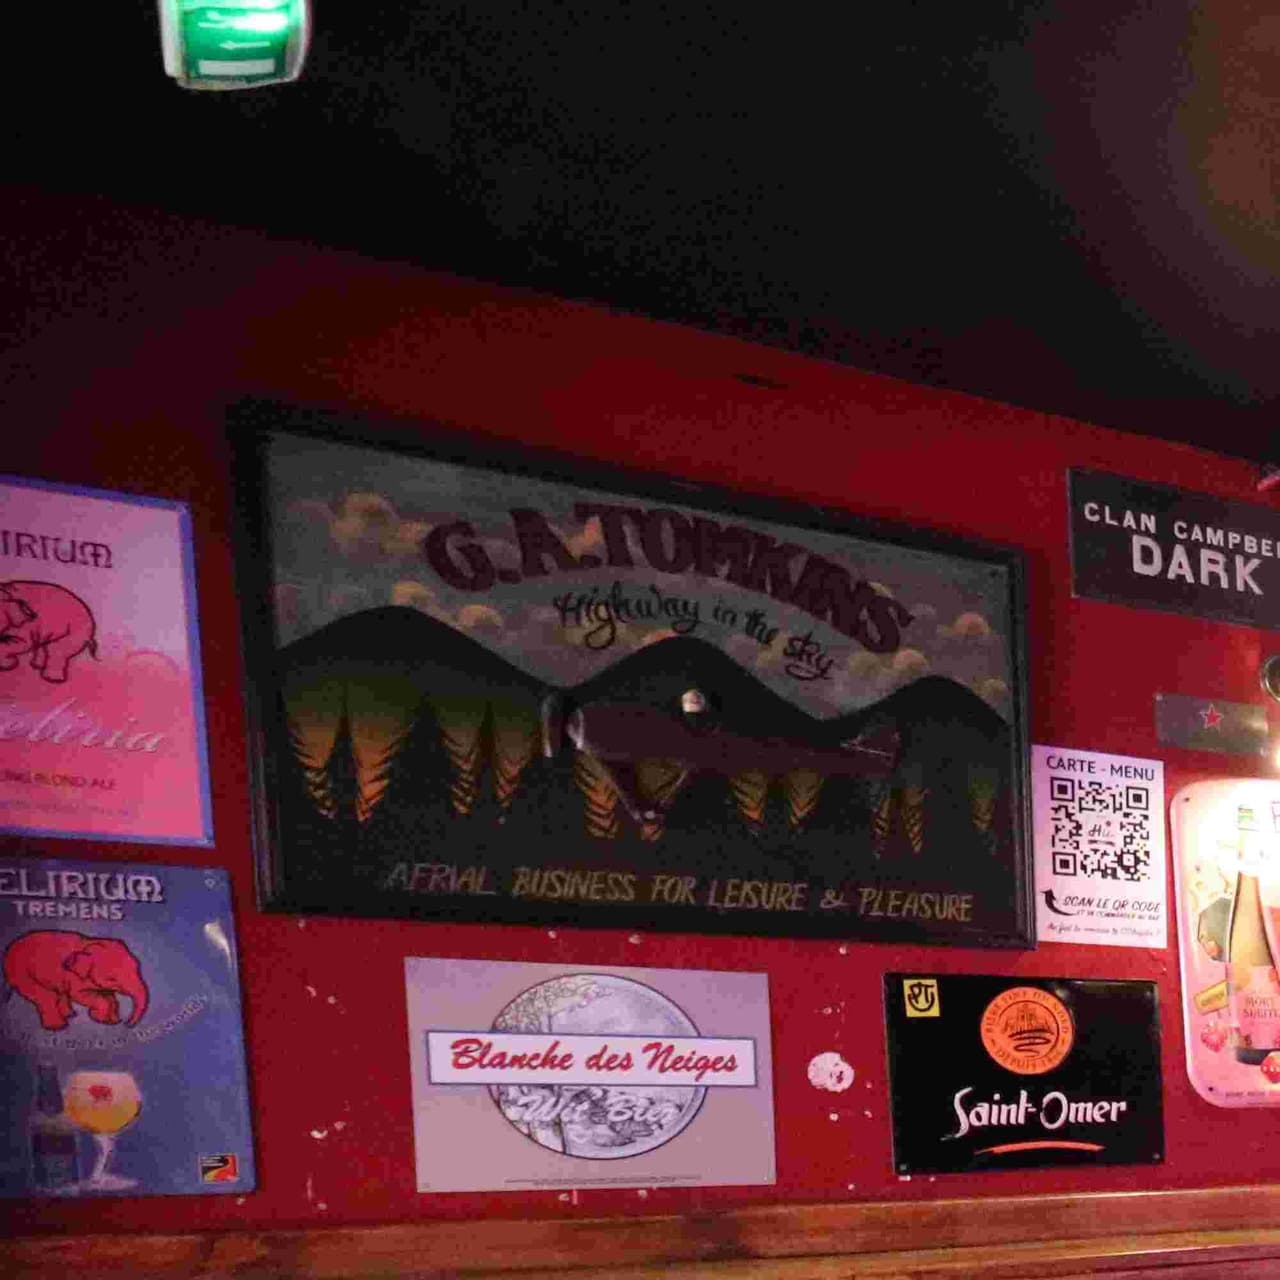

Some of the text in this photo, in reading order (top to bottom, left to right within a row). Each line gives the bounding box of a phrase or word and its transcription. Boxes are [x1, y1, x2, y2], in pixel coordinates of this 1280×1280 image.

[1083, 501, 1157, 535] CLAN
[1130, 536, 1265, 597] DARK
[552, 581, 835, 684] Highway in the sky
[1046, 755, 1097, 774] CARTE
[1109, 763, 1156, 781] MENU
[15, 900, 124, 920] TREMENS
[511, 866, 637, 904] BUSINESS
[652, 875, 699, 907] FOR
[708, 877, 809, 913] LEISURE
[820, 886, 847, 909] &
[857, 886, 974, 923] PLEASURE
[449, 1037, 739, 1083] Blanche des Neiges
[941, 1085, 1127, 1141] Saint-Omer
